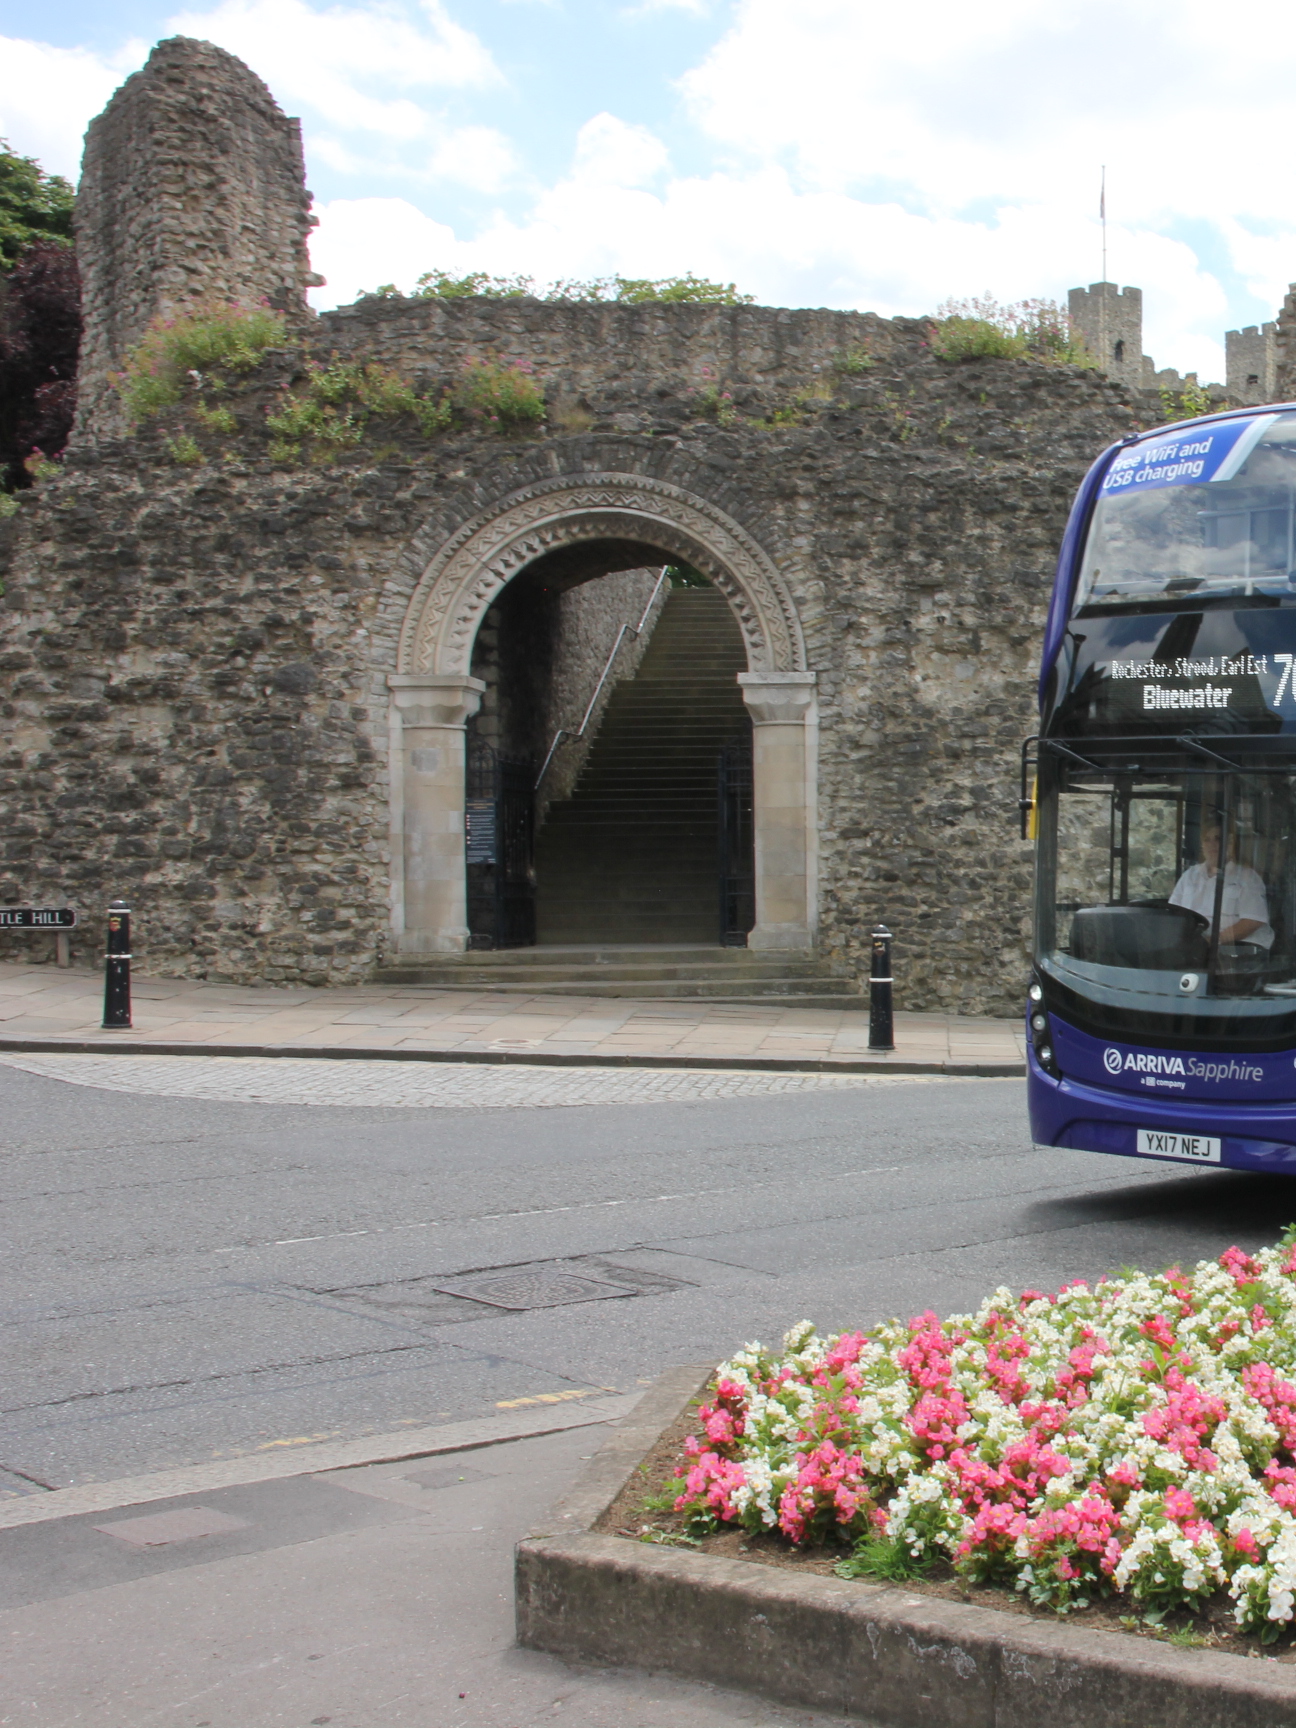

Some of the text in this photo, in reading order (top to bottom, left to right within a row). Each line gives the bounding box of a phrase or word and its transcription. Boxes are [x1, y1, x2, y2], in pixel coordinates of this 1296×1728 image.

[1109, 437, 1214, 472] Free WiFi and
[1102, 459, 1205, 489] USB charging
[1221, 655, 1245, 675] Earl
[1247, 654, 1268, 675] Est
[1143, 683, 1233, 709] Bluewater
[32, 912, 63, 924] HILL
[1123, 1053, 1264, 1083] ARRIVA Sapphire
[1156, 1079, 1186, 1090] company
[1146, 1133, 1210, 1156] YX17 NEJ
